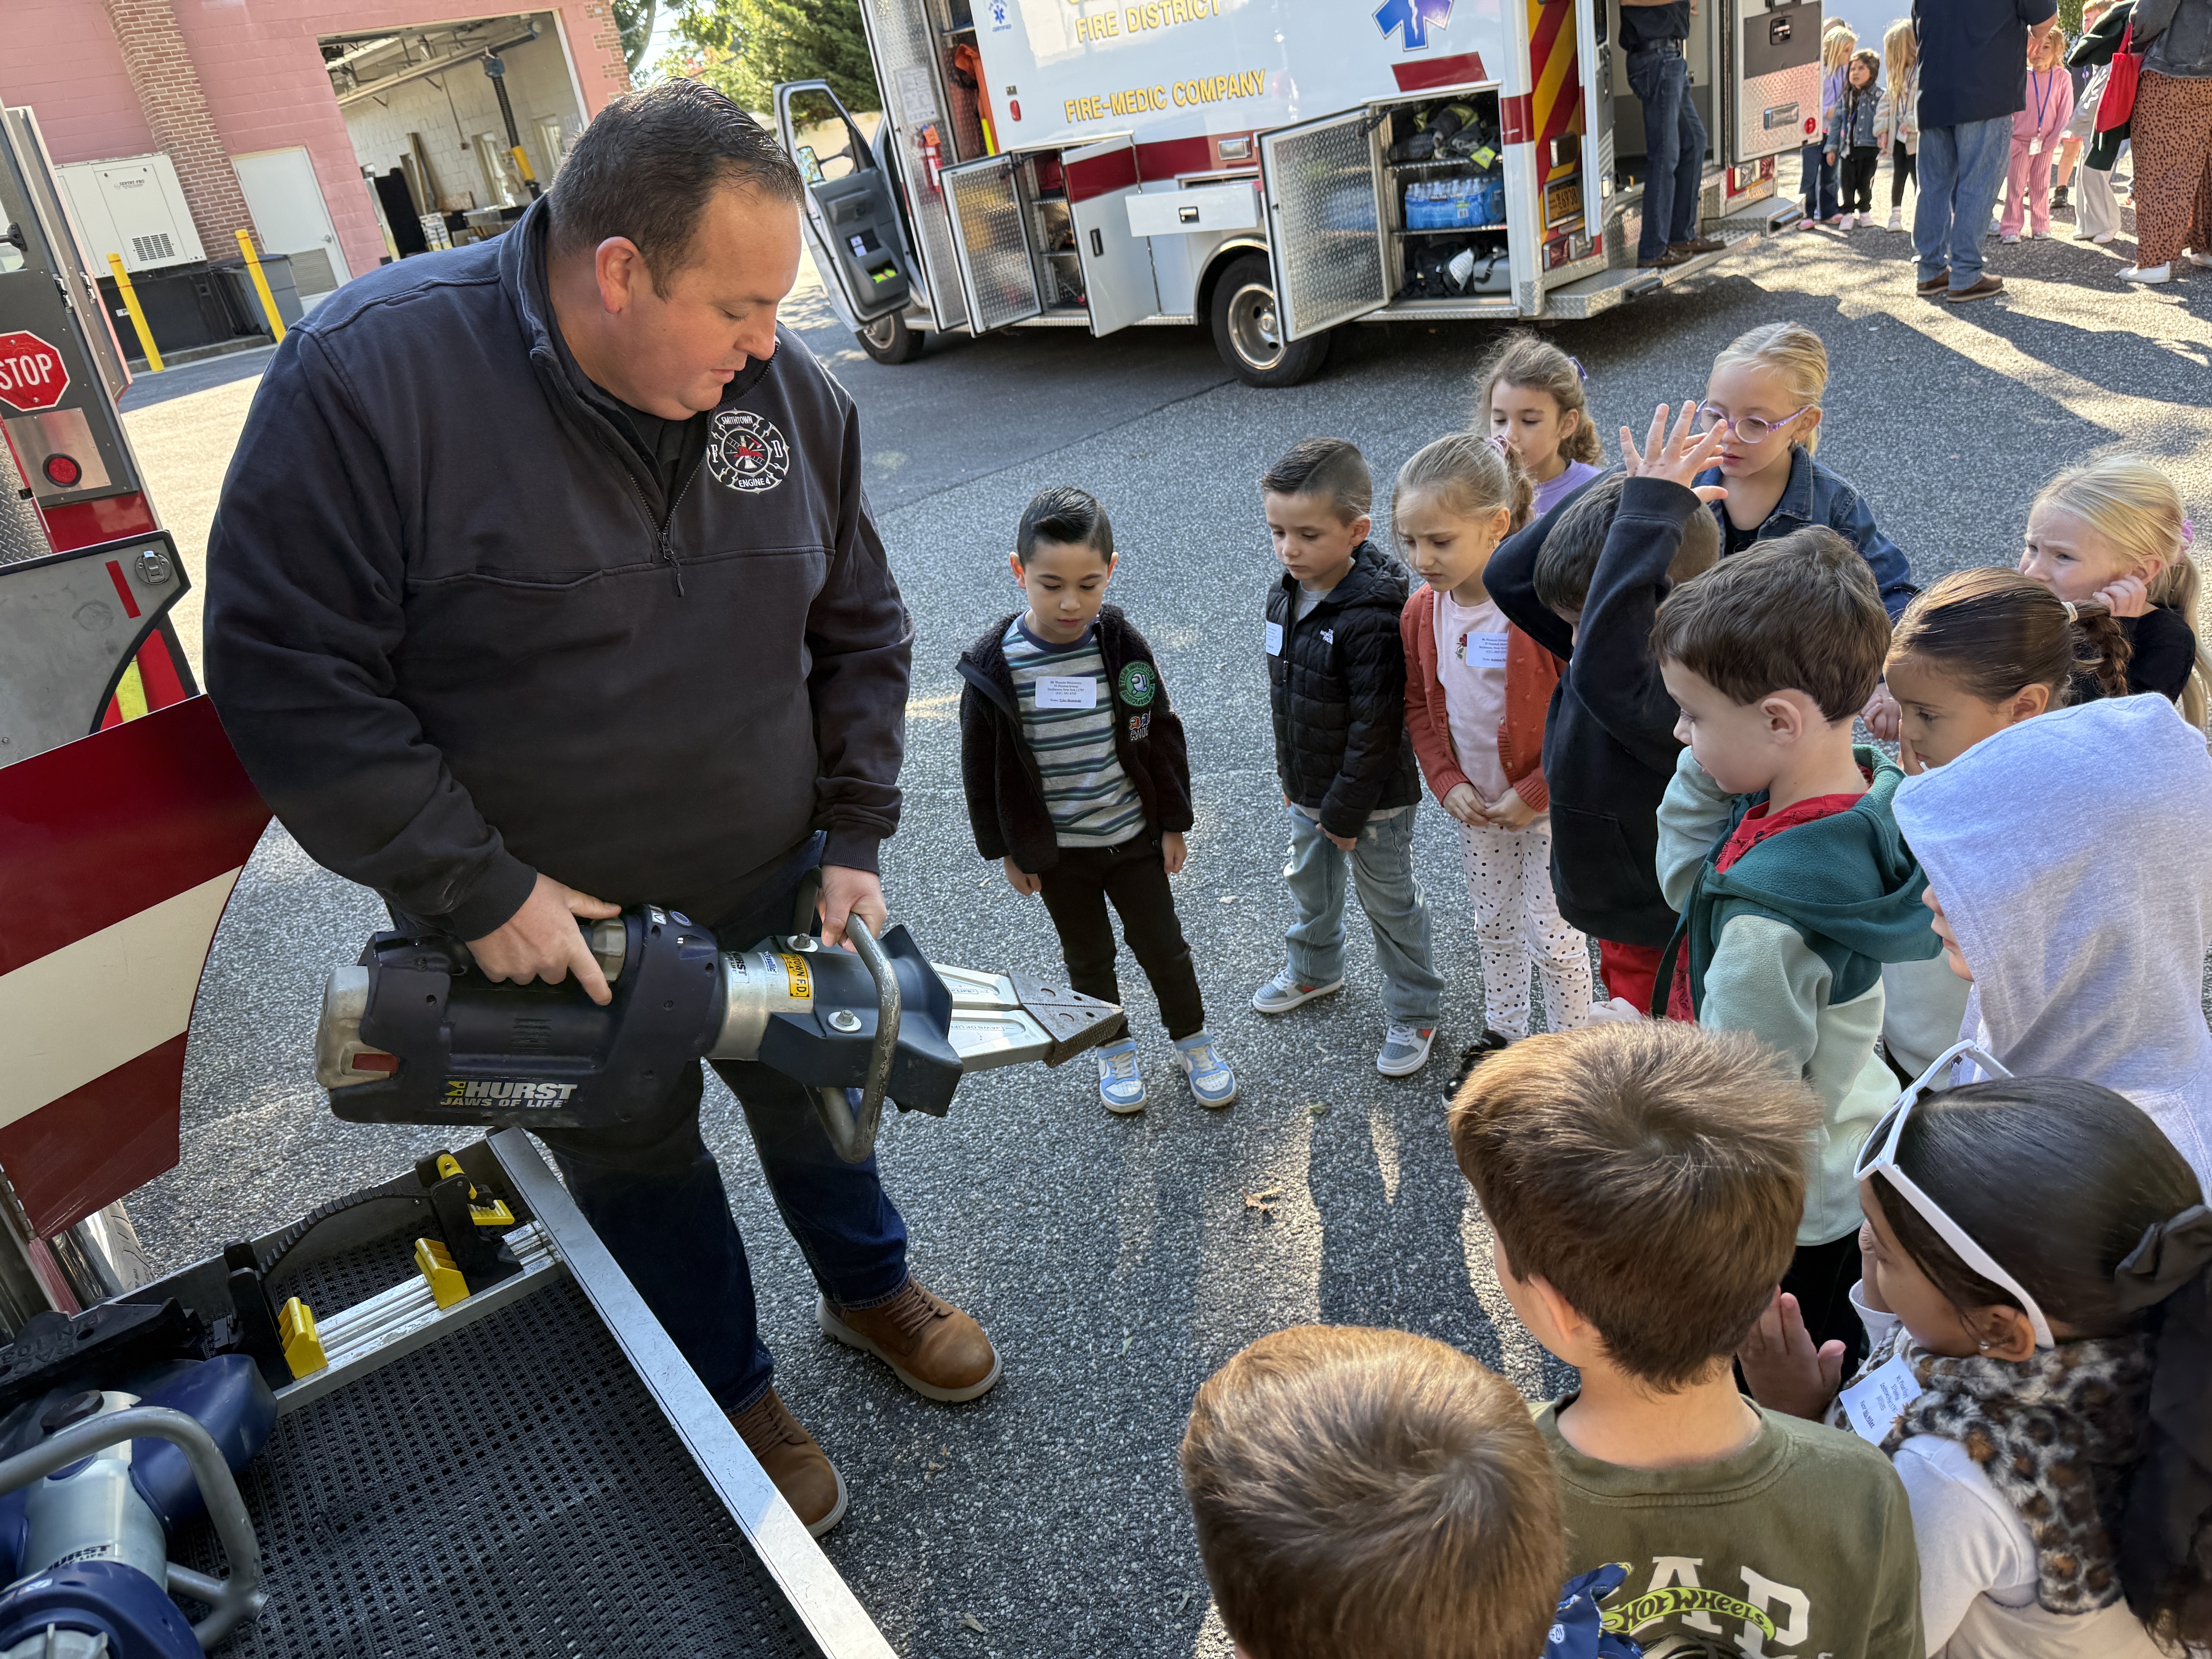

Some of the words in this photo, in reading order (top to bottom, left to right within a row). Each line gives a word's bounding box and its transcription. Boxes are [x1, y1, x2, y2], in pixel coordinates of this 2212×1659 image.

[1076, 12, 1119, 42] FIRE
[1127, 0, 1219, 32] DISTRICT
[1064, 86, 1167, 123] FIRE-MEDIC
[1172, 69, 1266, 107] COMPANY
[0, 354, 52, 390] STOP
[721, 416, 753, 424] SMITHTOWN
[771, 440, 783, 458] D
[738, 478, 765, 487] ENGINE
[465, 1081, 578, 1100] HURST
[440, 1098, 492, 1106] JAWS
[1614, 1595, 1669, 1631] HOT
